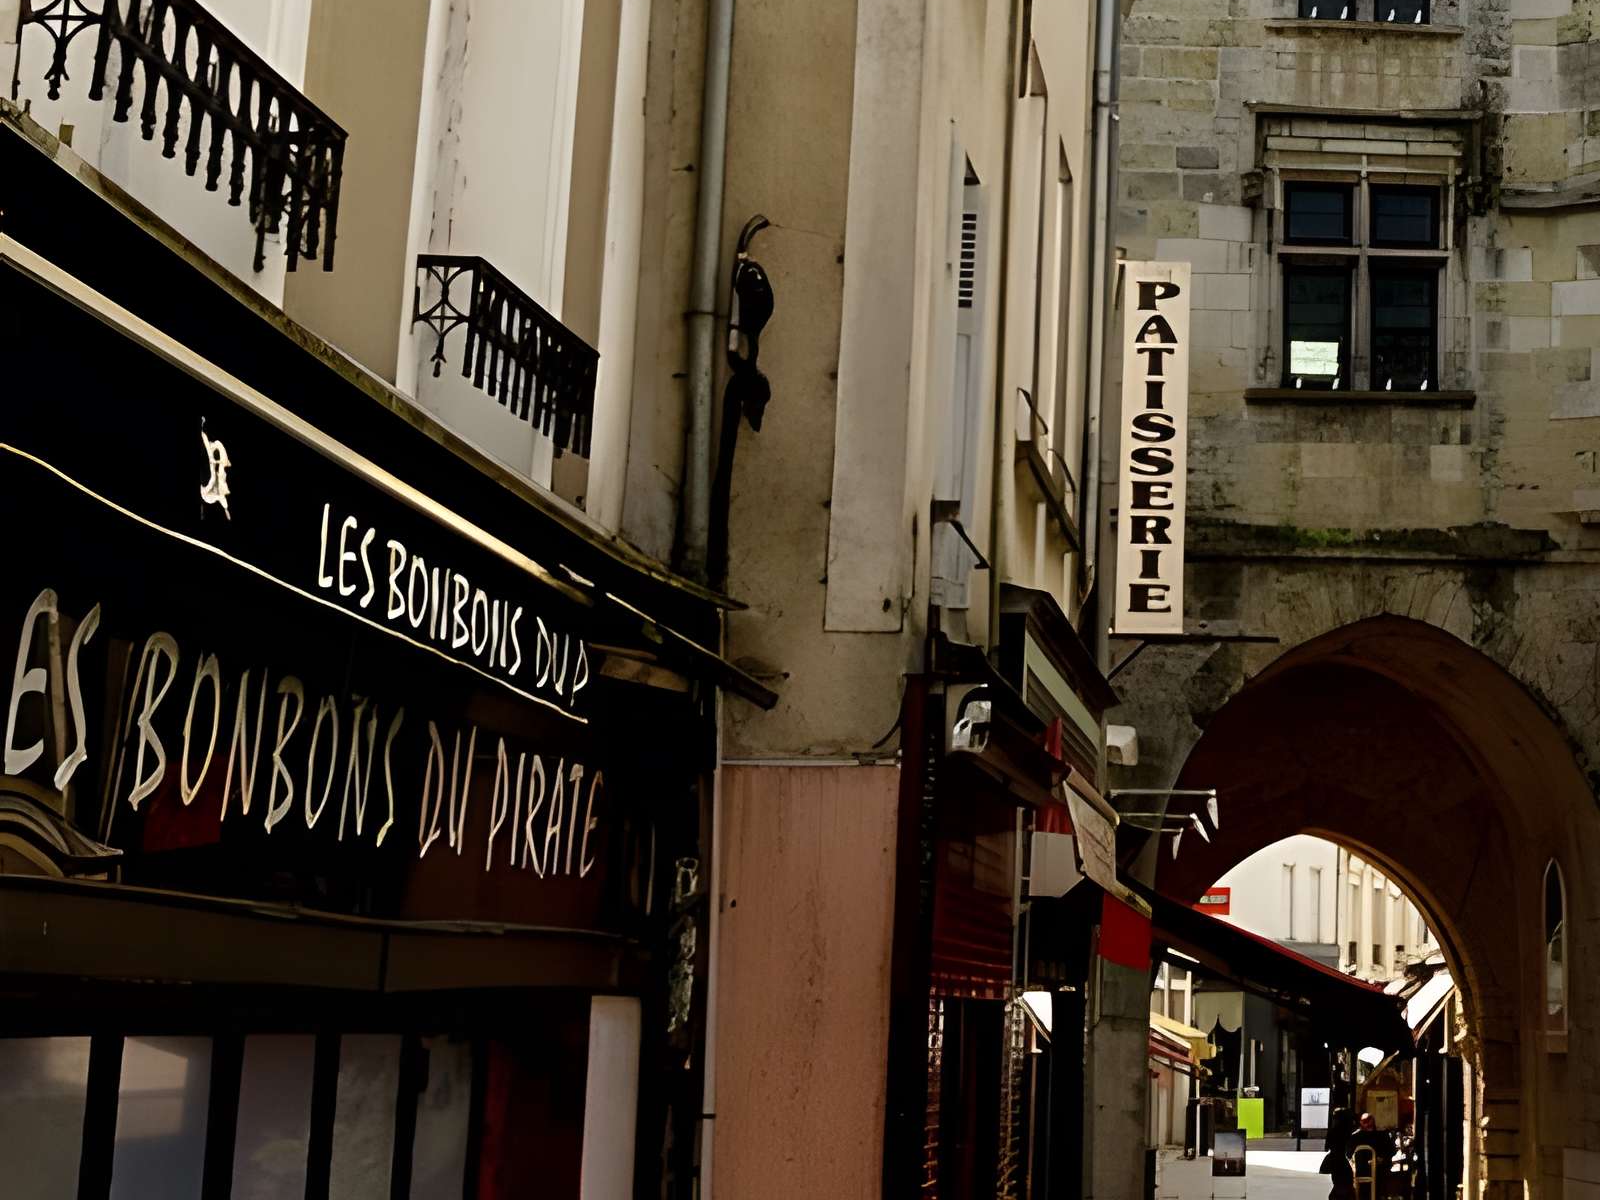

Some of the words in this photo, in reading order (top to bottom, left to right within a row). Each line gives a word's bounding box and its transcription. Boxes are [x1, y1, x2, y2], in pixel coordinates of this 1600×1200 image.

[1128, 281, 1181, 613] PATISSERIE
[317, 502, 376, 609] LES
[536, 616, 571, 696] DU
[126, 630, 405, 849] BONBONS
[418, 719, 479, 860] DU
[484, 736, 605, 880] PIRATE
